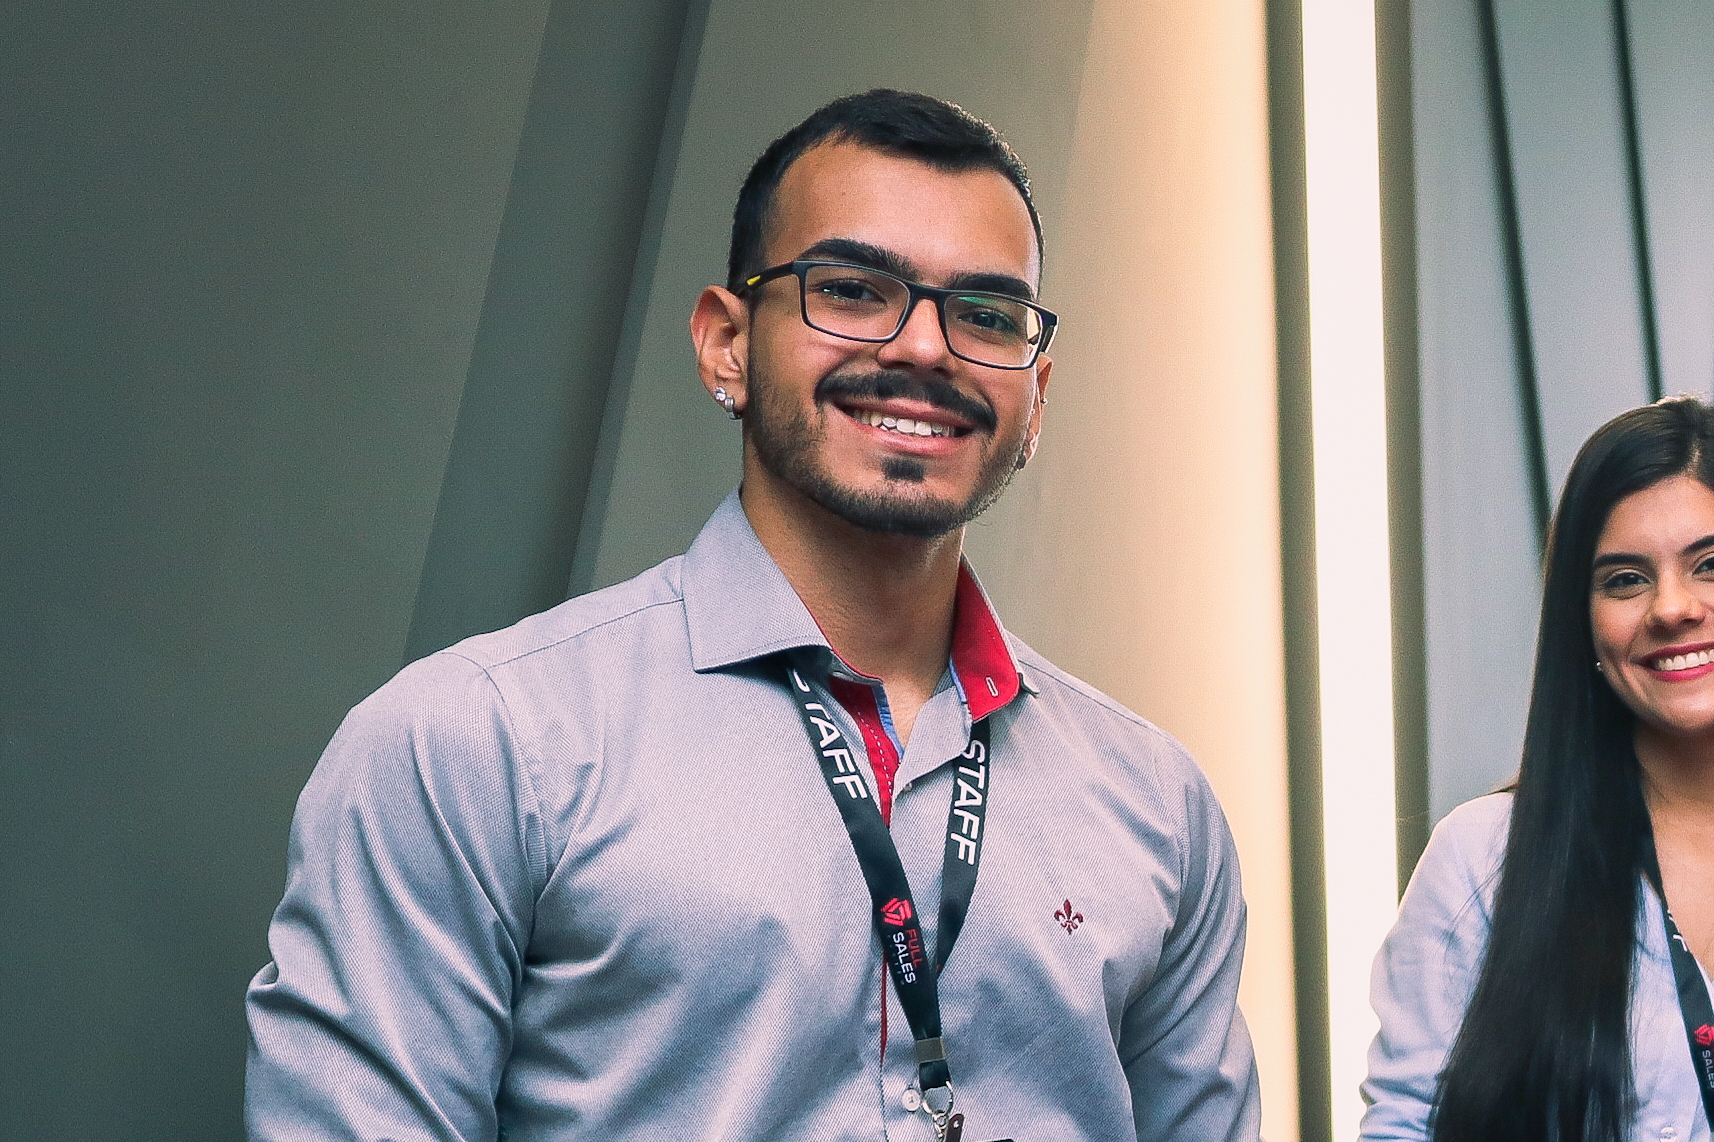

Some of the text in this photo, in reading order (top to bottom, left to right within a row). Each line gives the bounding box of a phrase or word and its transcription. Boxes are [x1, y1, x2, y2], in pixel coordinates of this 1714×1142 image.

[951, 739, 986, 866] STAFF
[893, 931, 916, 984] SALES
[905, 928, 923, 970] FULL
